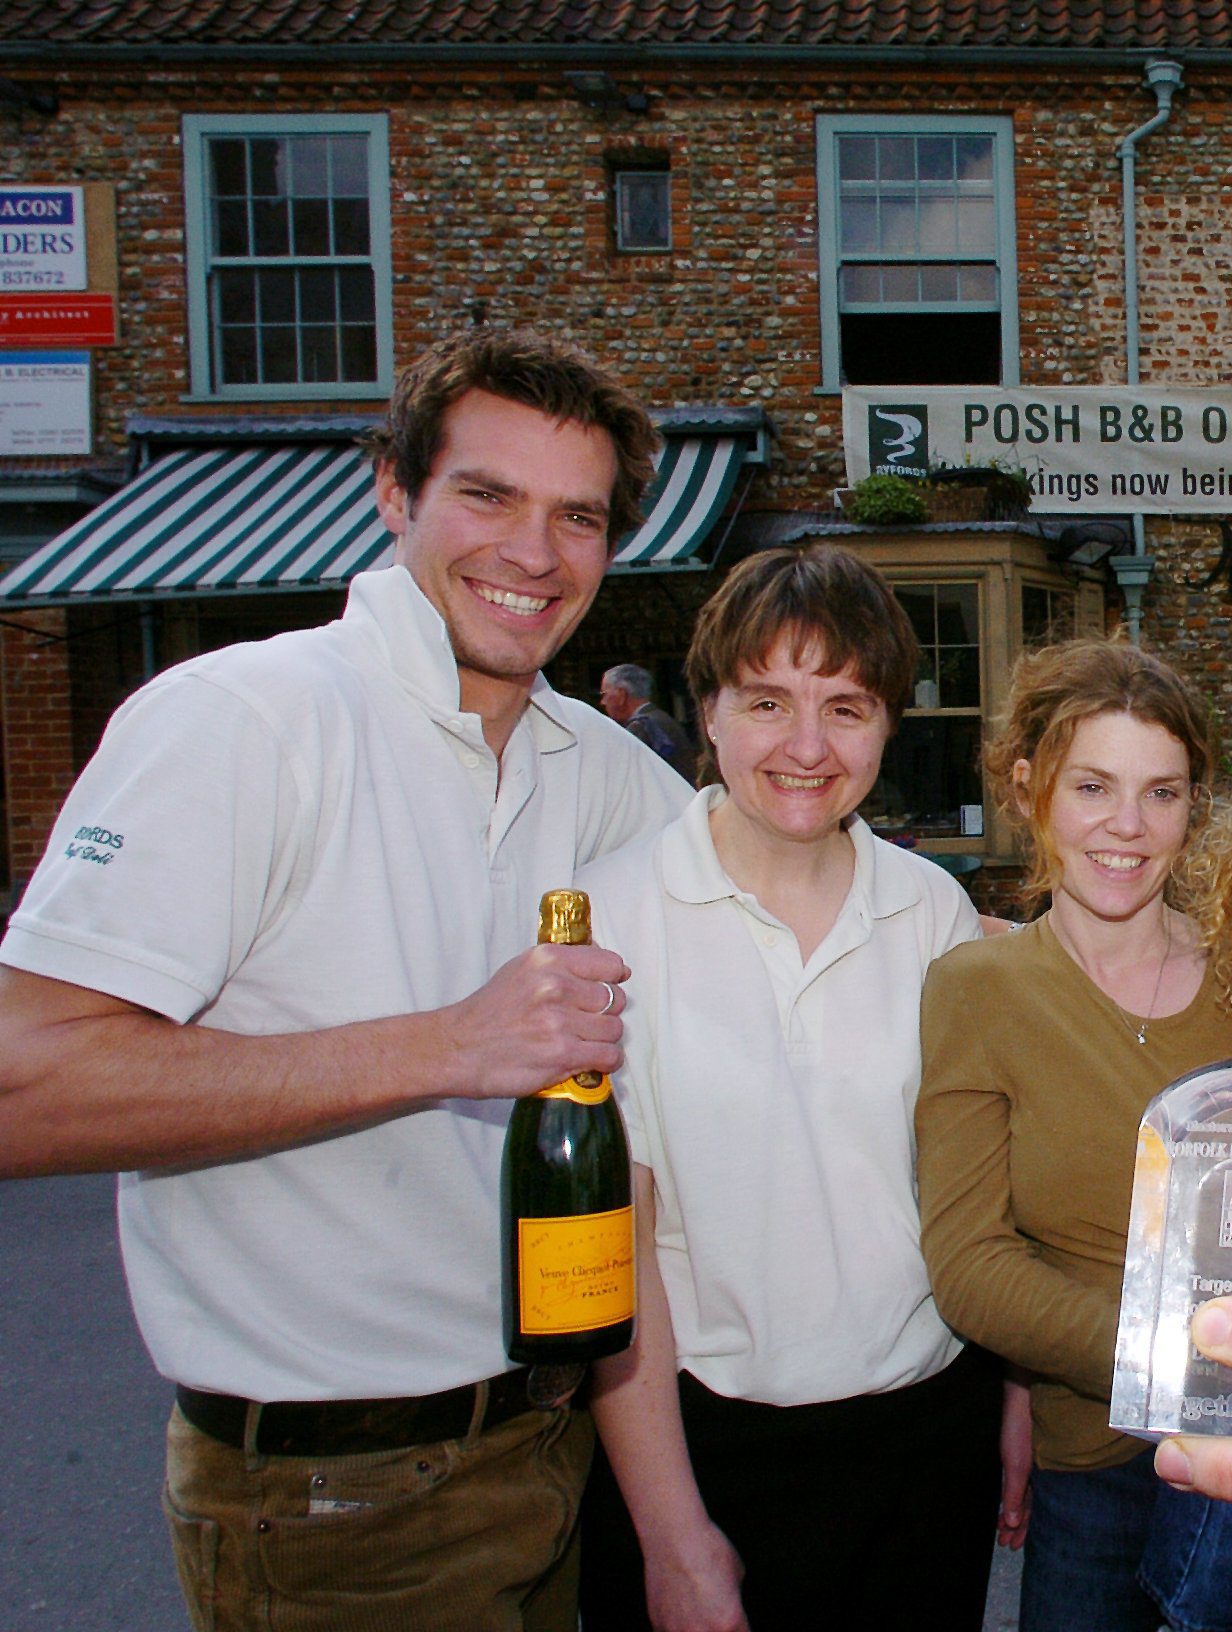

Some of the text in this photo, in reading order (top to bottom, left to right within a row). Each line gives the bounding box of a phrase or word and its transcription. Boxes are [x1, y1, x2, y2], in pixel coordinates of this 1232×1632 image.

[3, 271, 64, 284] 837672
[964, 403, 1080, 443] POSH
[1099, 404, 1184, 443] B&B
[1111, 473, 1169, 496] now
